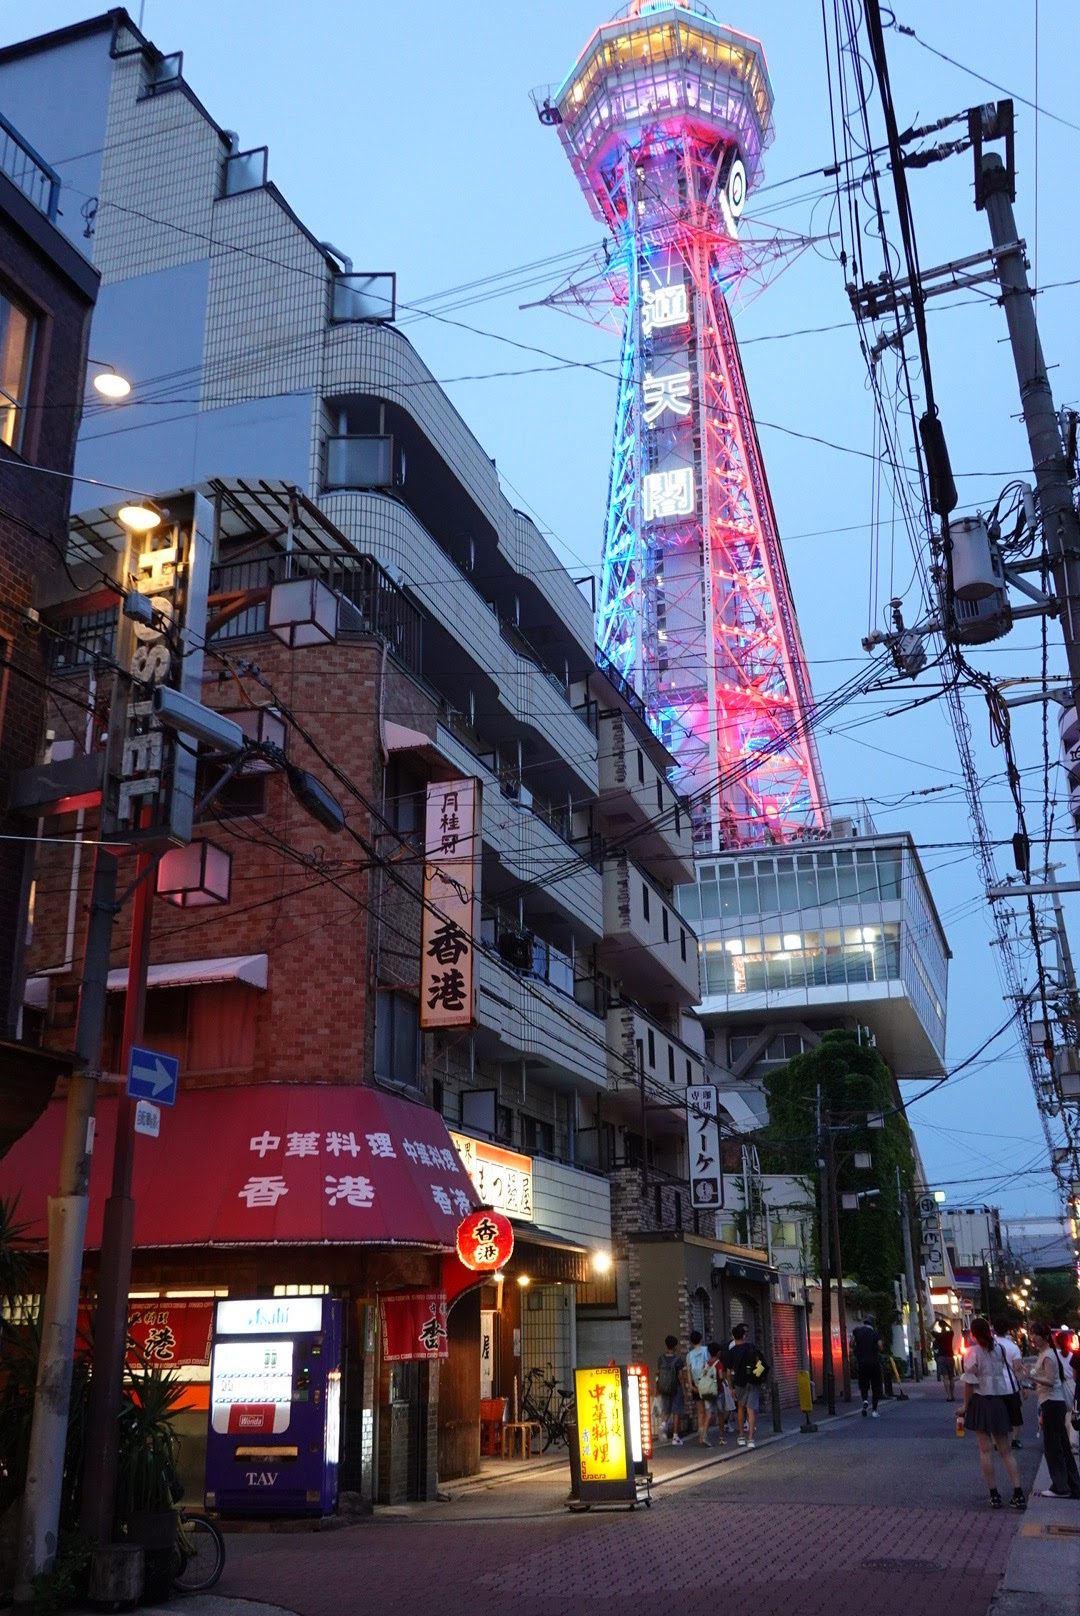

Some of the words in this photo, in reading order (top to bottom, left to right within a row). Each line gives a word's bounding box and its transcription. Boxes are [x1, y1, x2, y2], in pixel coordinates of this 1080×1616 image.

[642, 283, 695, 522] 通天閣
[439, 791, 461, 855] 月桂冠
[426, 922, 468, 1011] 香港
[249, 1130, 397, 1159] 中華料理
[402, 1137, 460, 1173] 中華料理
[238, 1174, 376, 1208] 香港
[430, 1184, 476, 1218] 香港
[473, 1217, 498, 1263] 香港
[588, 1384, 610, 1463] 中華料理
